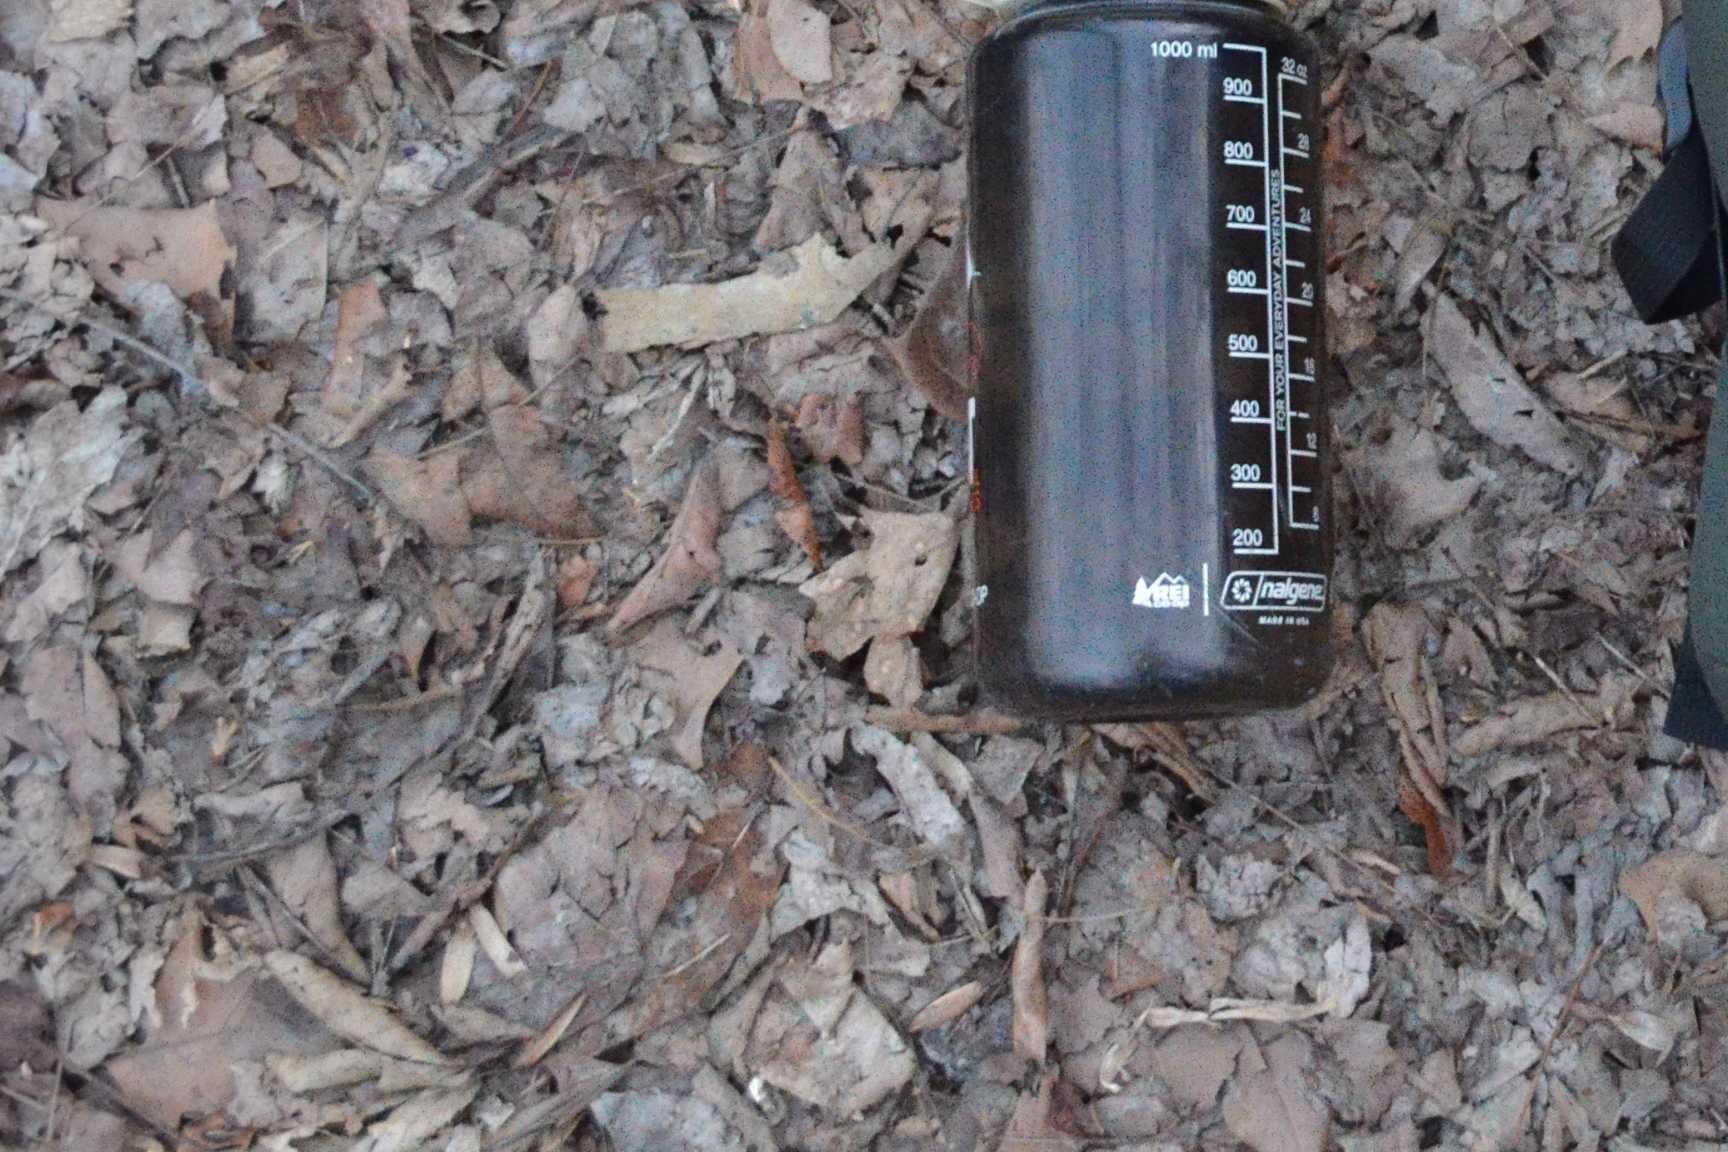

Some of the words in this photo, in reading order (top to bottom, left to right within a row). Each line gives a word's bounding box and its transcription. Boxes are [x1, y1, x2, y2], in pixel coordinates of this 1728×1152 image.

[1151, 41, 1192, 58] 1000
[1197, 42, 1218, 59] ml
[1281, 56, 1295, 73] 32
[1223, 77, 1252, 95] 900
[1223, 141, 1253, 159] 800
[1226, 204, 1255, 223] 700
[1270, 169, 1282, 267] ADVENTURES
[1227, 269, 1257, 287] 600
[1273, 271, 1284, 350] EVERYDAY
[1228, 333, 1258, 352] 500
[1275, 353, 1285, 395] YOUR
[1230, 399, 1260, 417] 400
[1276, 399, 1286, 431] FOR
[1231, 463, 1261, 482] 300
[1232, 528, 1263, 546] 200
[1153, 584, 1190, 601] REI
[1261, 577, 1323, 605] nalgene
